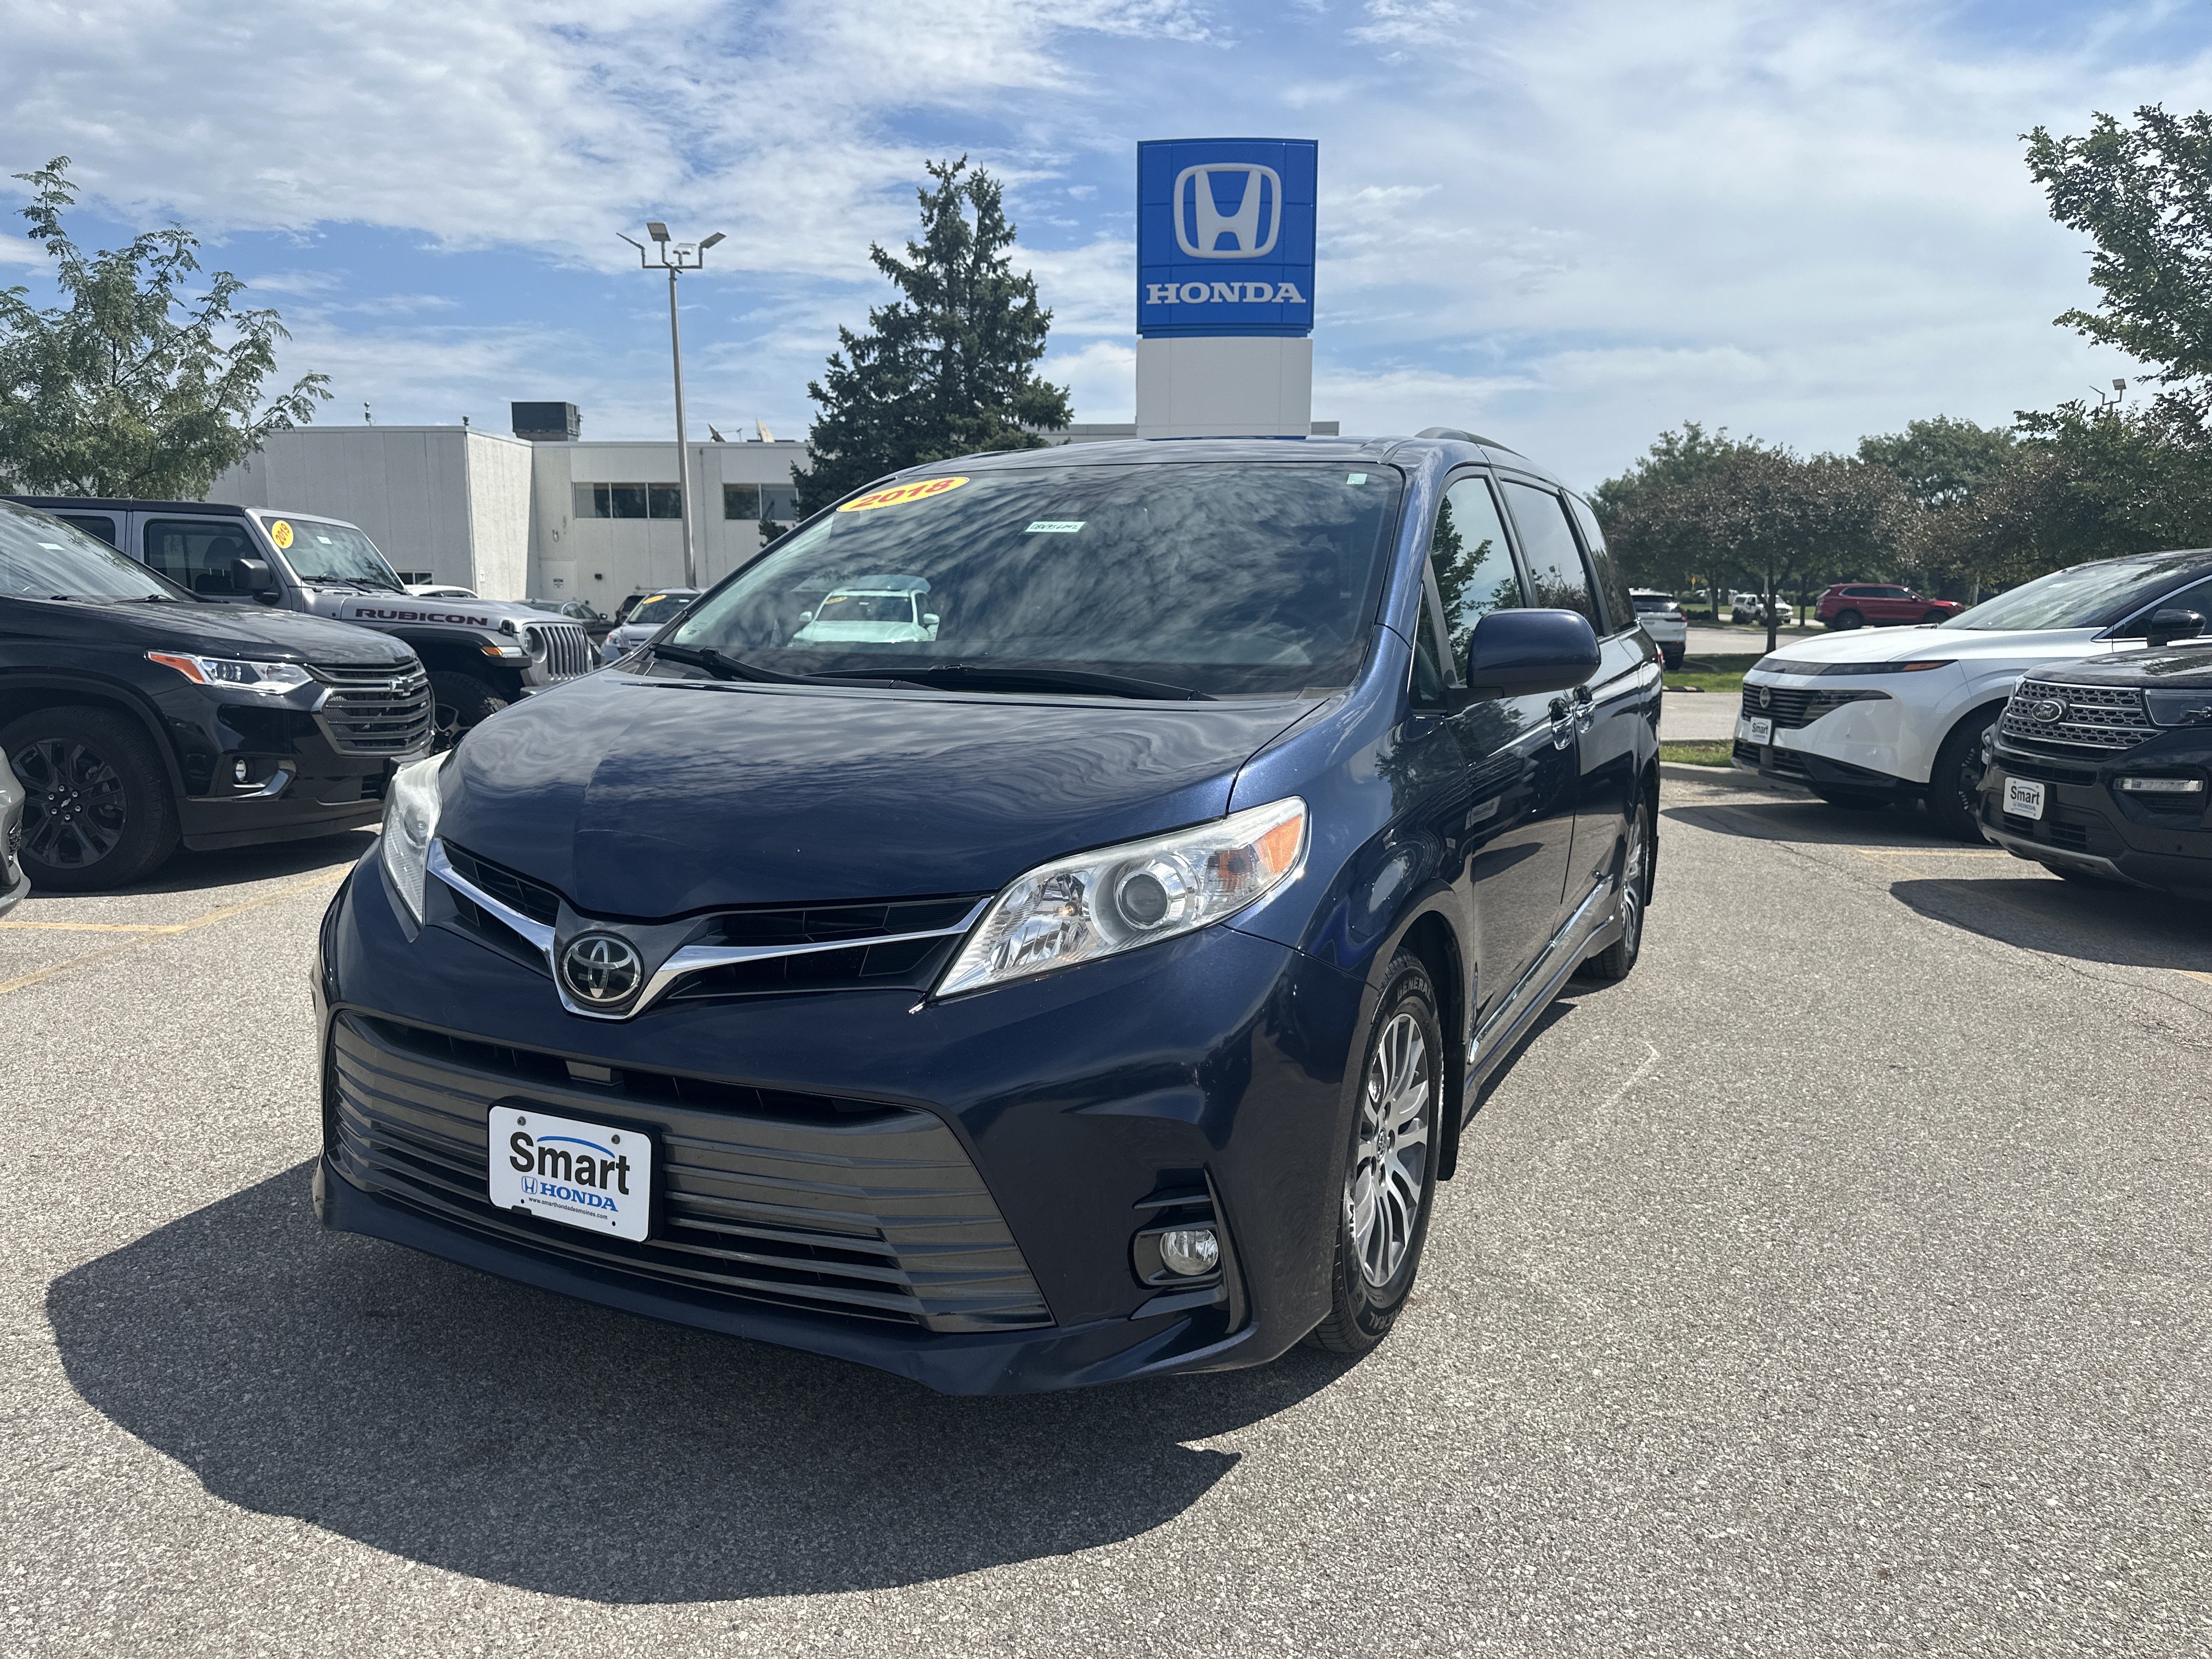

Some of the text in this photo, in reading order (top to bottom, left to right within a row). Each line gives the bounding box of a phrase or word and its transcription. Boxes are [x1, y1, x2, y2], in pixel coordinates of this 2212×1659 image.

[1147, 282, 1307, 304] HONDA
[849, 479, 955, 510] 2018
[276, 523, 290, 545] 2019
[355, 608, 489, 626] RUBICON
[1752, 723, 1769, 735] Smart
[2010, 786, 2040, 805] Smart
[1397, 976, 1431, 1002] GENERAL
[510, 1131, 630, 1195] Smart
[540, 1182, 618, 1212] HONDA
[528, 1197, 608, 1220] www.smarthondadesmoines.com
